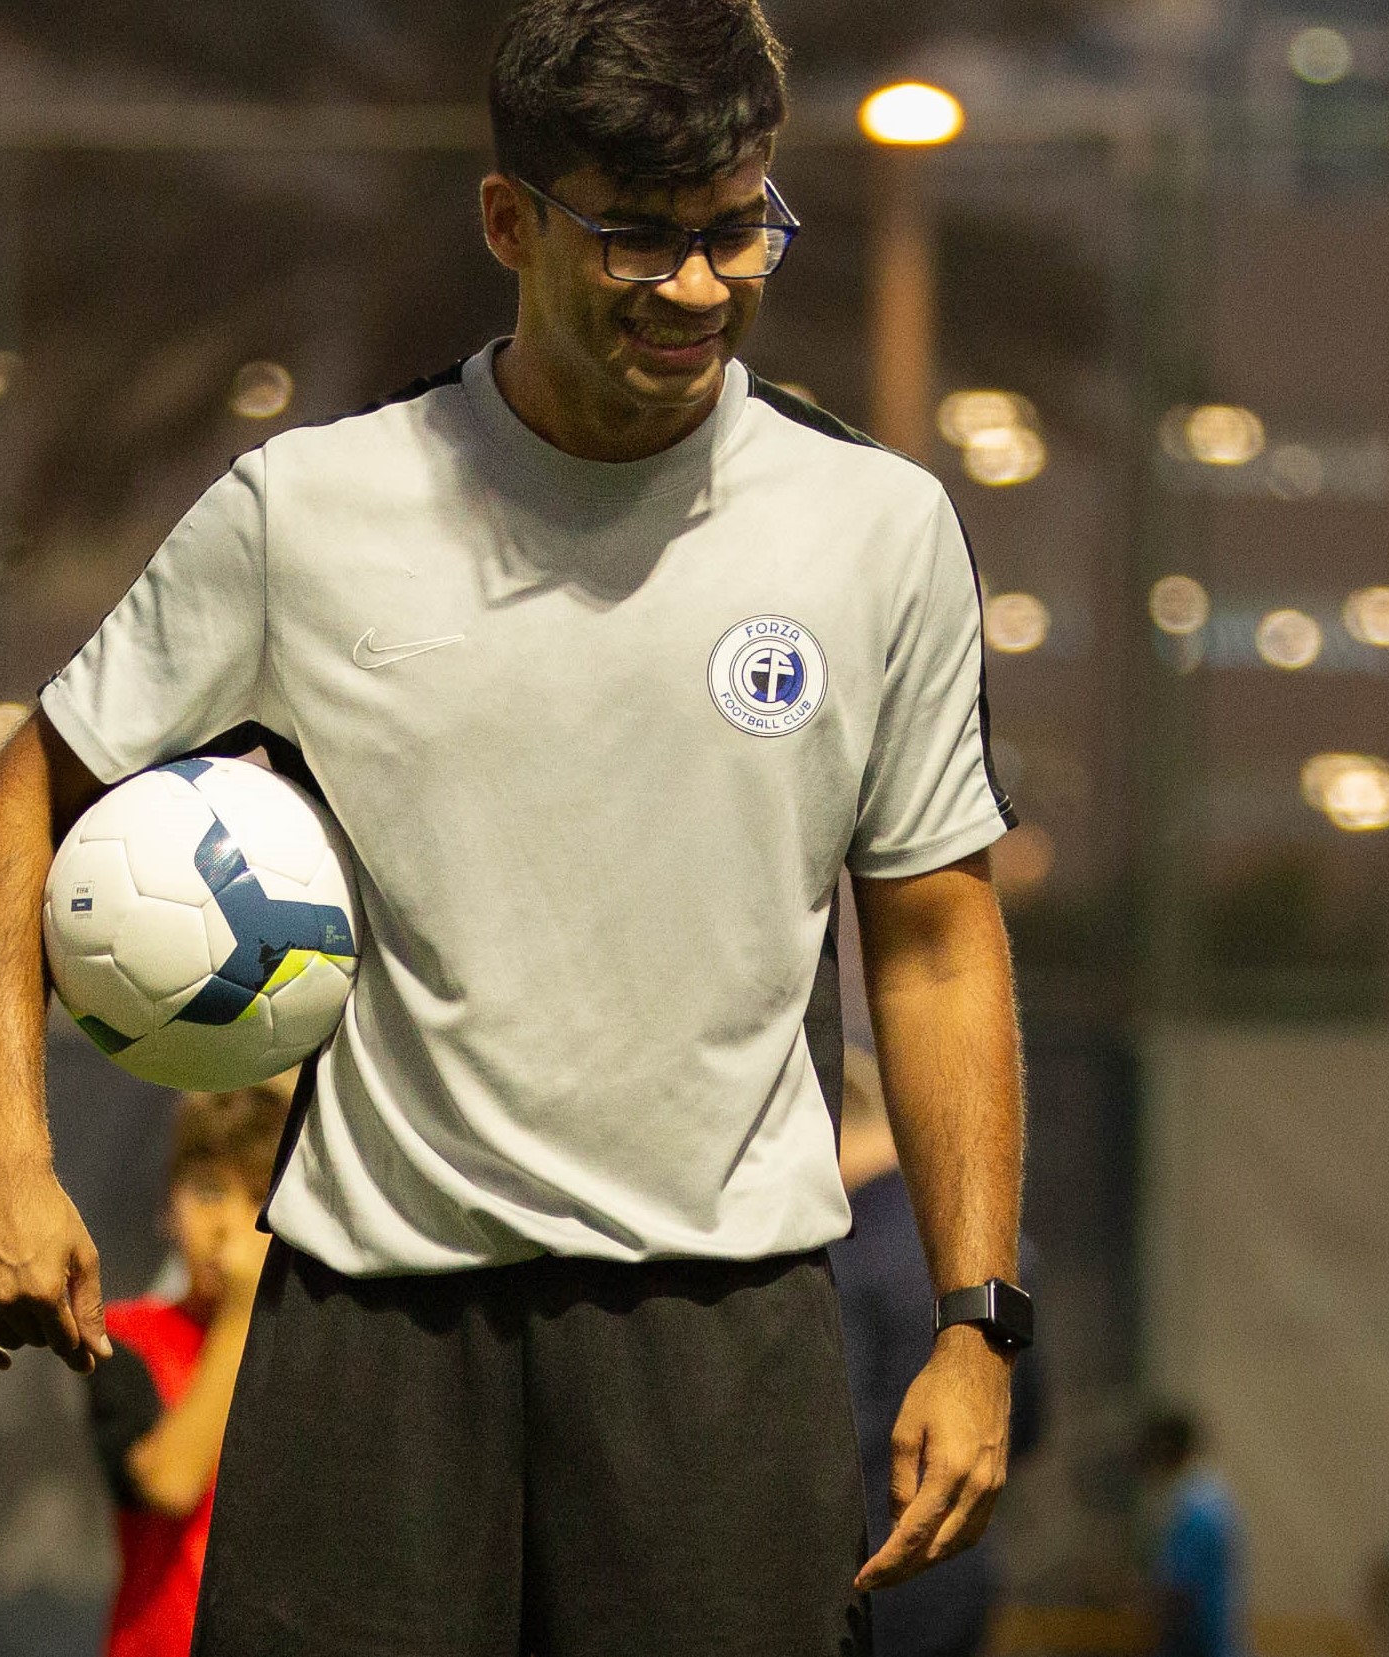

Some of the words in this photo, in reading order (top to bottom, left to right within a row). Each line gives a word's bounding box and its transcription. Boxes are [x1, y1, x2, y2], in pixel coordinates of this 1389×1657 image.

[745, 622, 800, 642] FORZA
[720, 691, 780, 729] FOOTBALL
[784, 700, 812, 725] CLUB
